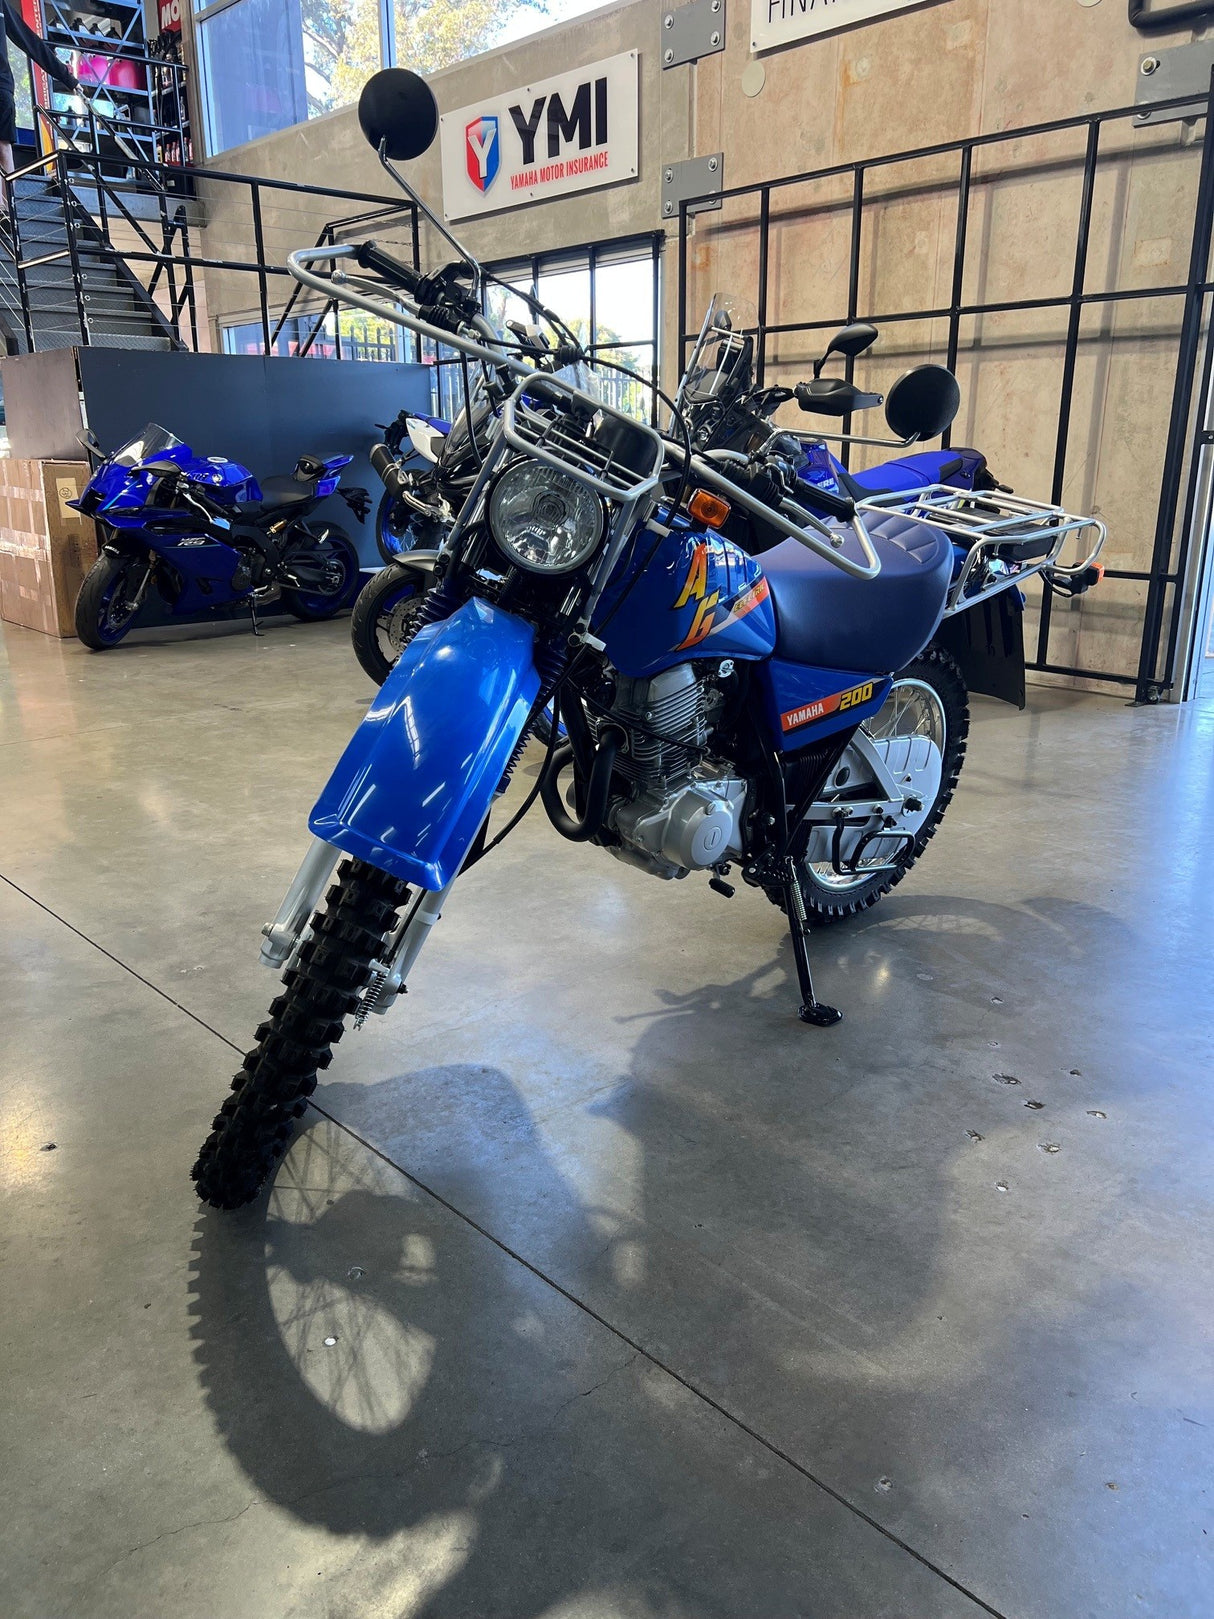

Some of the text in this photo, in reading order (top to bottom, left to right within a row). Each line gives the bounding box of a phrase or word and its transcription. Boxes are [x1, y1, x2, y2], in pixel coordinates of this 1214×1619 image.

[508, 76, 608, 165] YMI
[510, 151, 608, 190] YAMAHA MOTOR INSURANCE
[786, 682, 873, 726] YAMAHA 200
